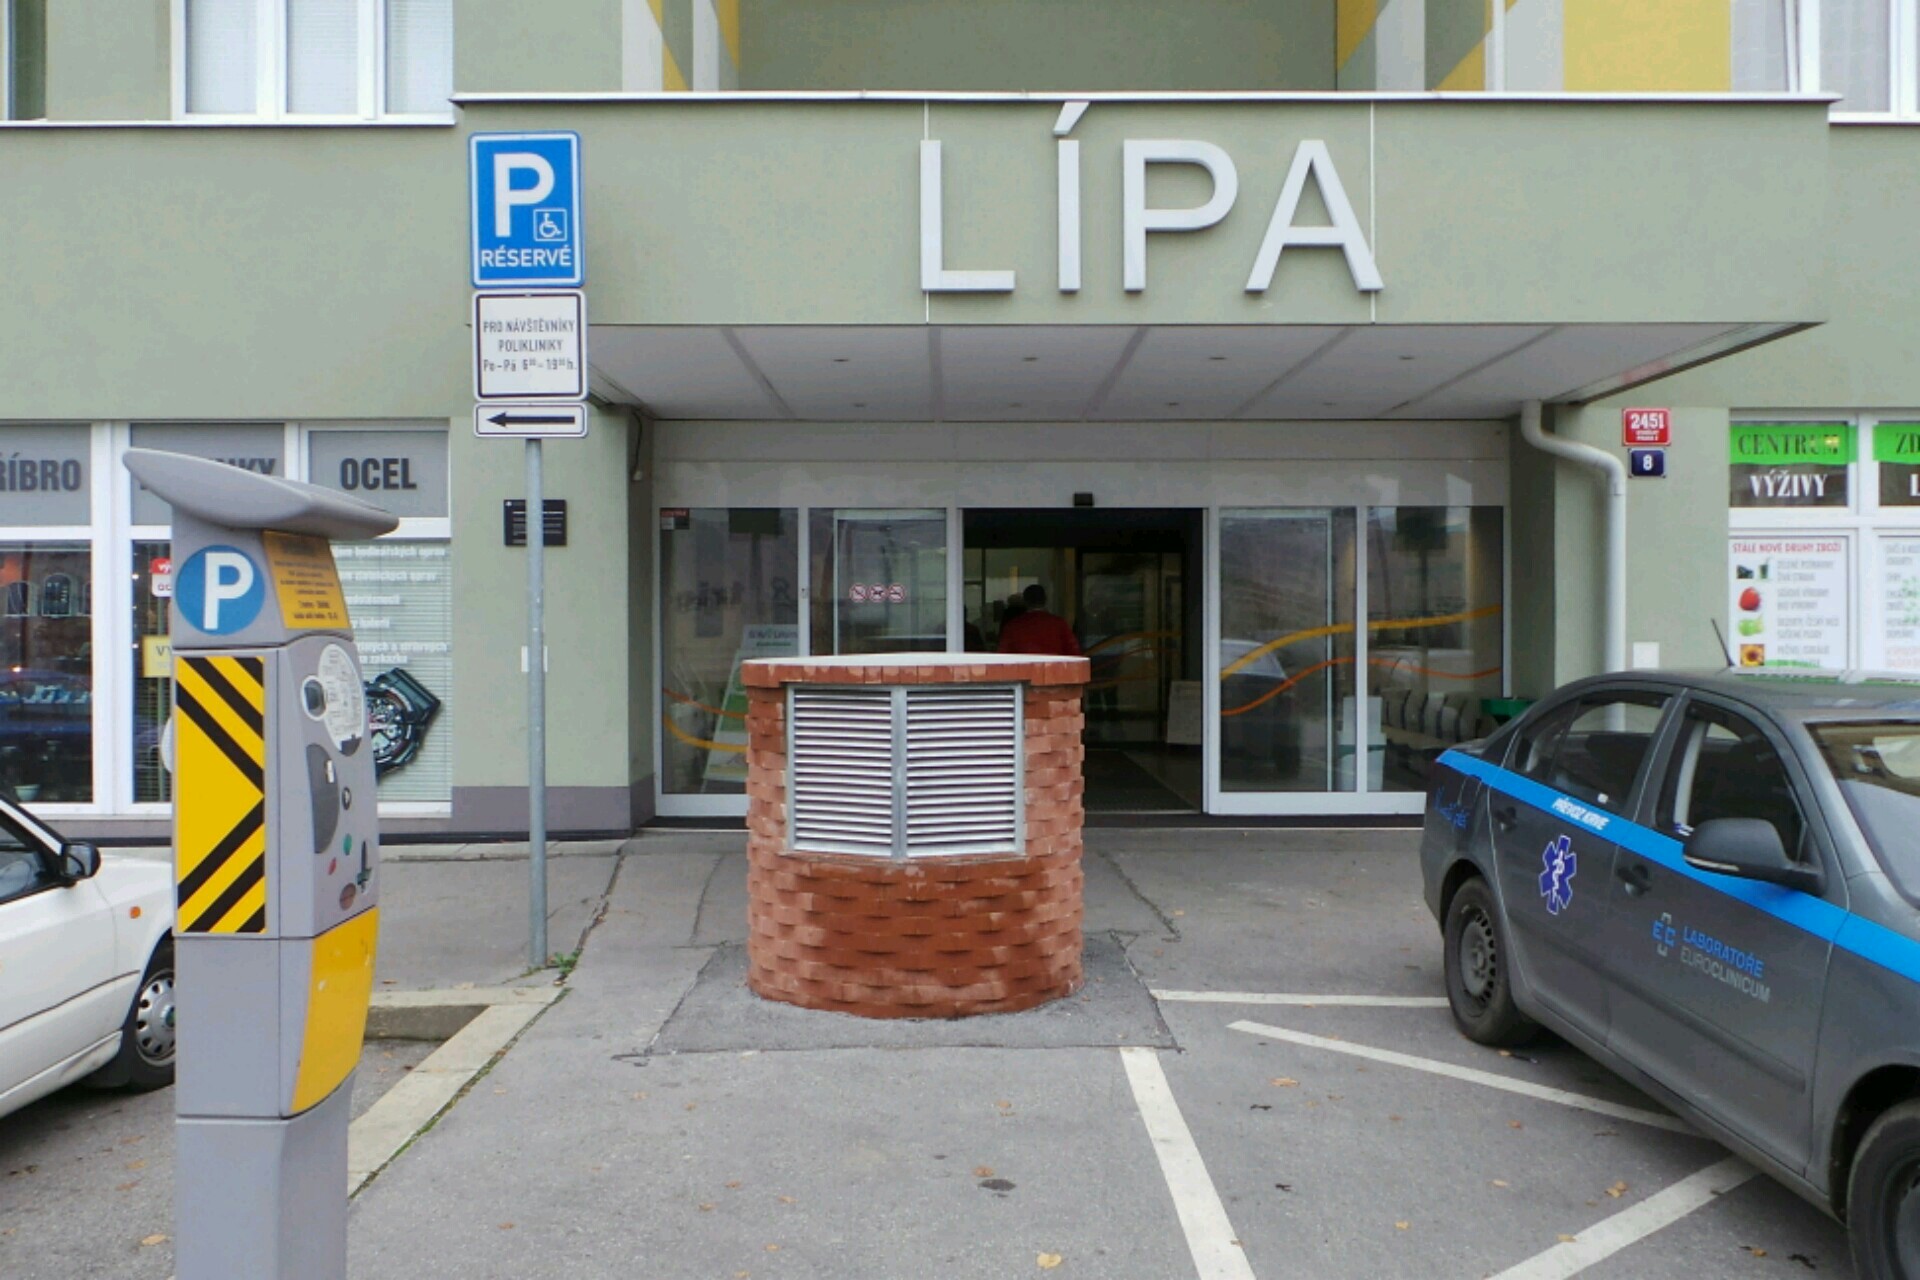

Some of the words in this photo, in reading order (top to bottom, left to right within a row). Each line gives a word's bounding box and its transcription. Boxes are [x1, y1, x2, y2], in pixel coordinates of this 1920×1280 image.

[493, 153, 555, 238] P
[920, 101, 1384, 292] LÍPA
[481, 244, 572, 268] RÉSERVÉ
[483, 321, 503, 333] PRO
[498, 339, 563, 352] POLIKLINIKY
[1631, 412, 1665, 430] 2451
[341, 457, 417, 490] OCEL
[1642, 454, 1653, 472] 8
[1750, 469, 1828, 498] VÝŽIVY
[204, 552, 253, 630] P
[1683, 925, 1765, 979] LABORATOŘE
[1680, 945, 1770, 1004] EUROCLINICUM
